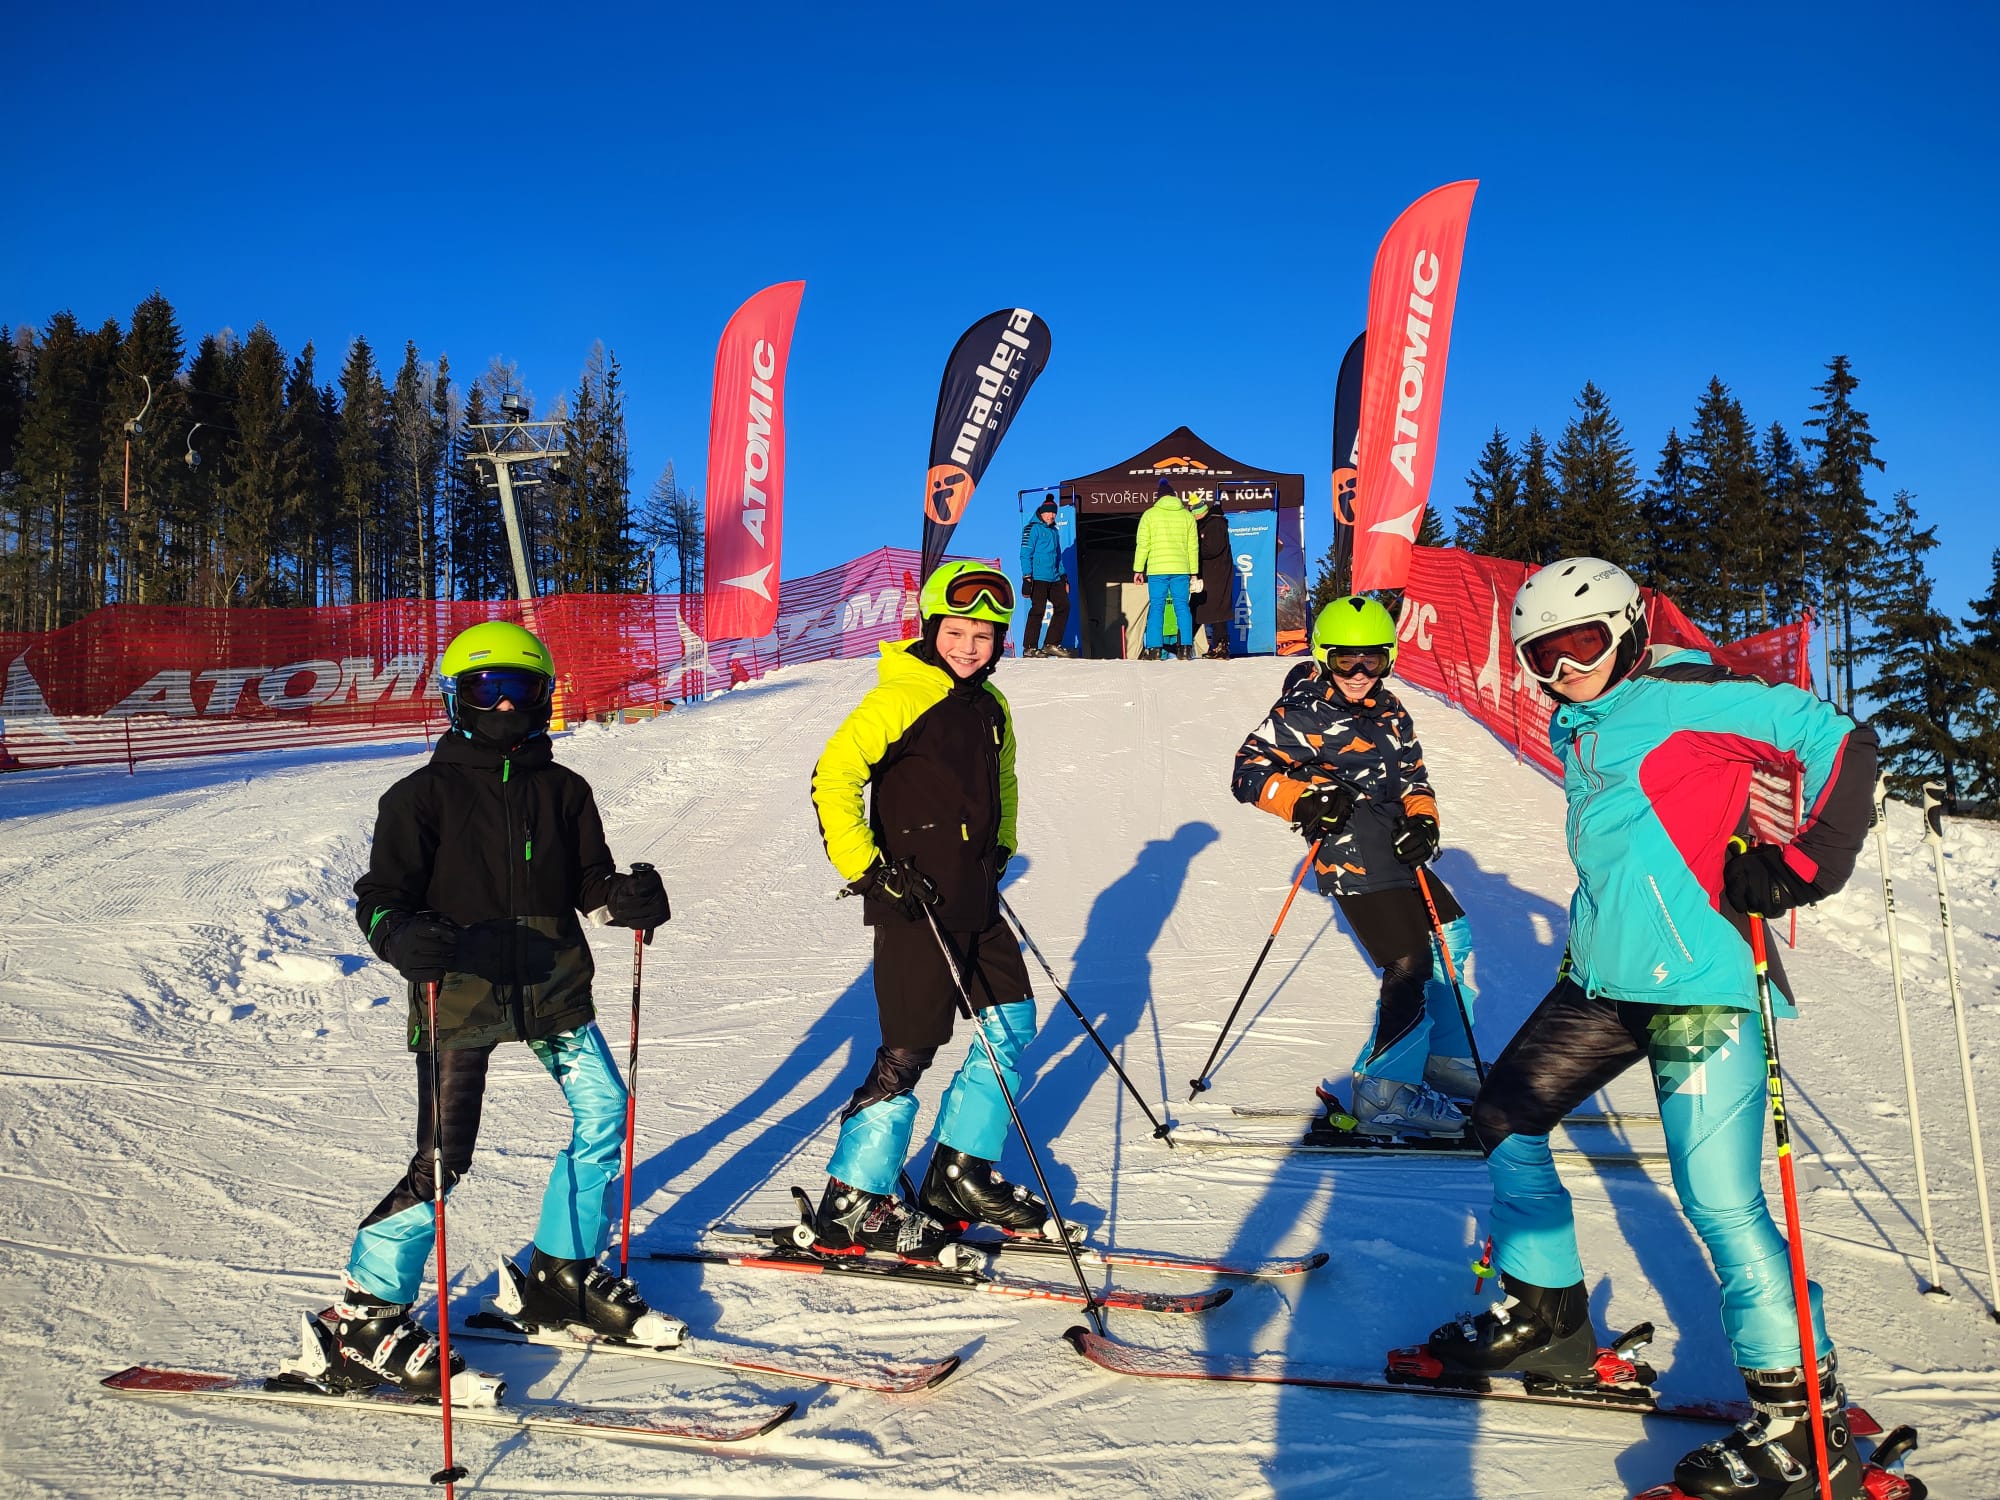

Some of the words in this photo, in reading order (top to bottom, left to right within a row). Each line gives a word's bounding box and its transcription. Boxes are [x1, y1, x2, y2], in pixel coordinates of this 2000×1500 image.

[987, 351, 1026, 430] SPORT
[1391, 249, 1440, 488] ATOMIC
[742, 339, 775, 549] ATOMIC
[1091, 489, 1149, 504] STVOŘEN
[1220, 490, 1229, 501] A
[1235, 487, 1273, 501] KOLA
[1234, 554, 1254, 642] START
[1884, 878, 1896, 914] LEKI
[1767, 1059, 1786, 1121] LEKI
